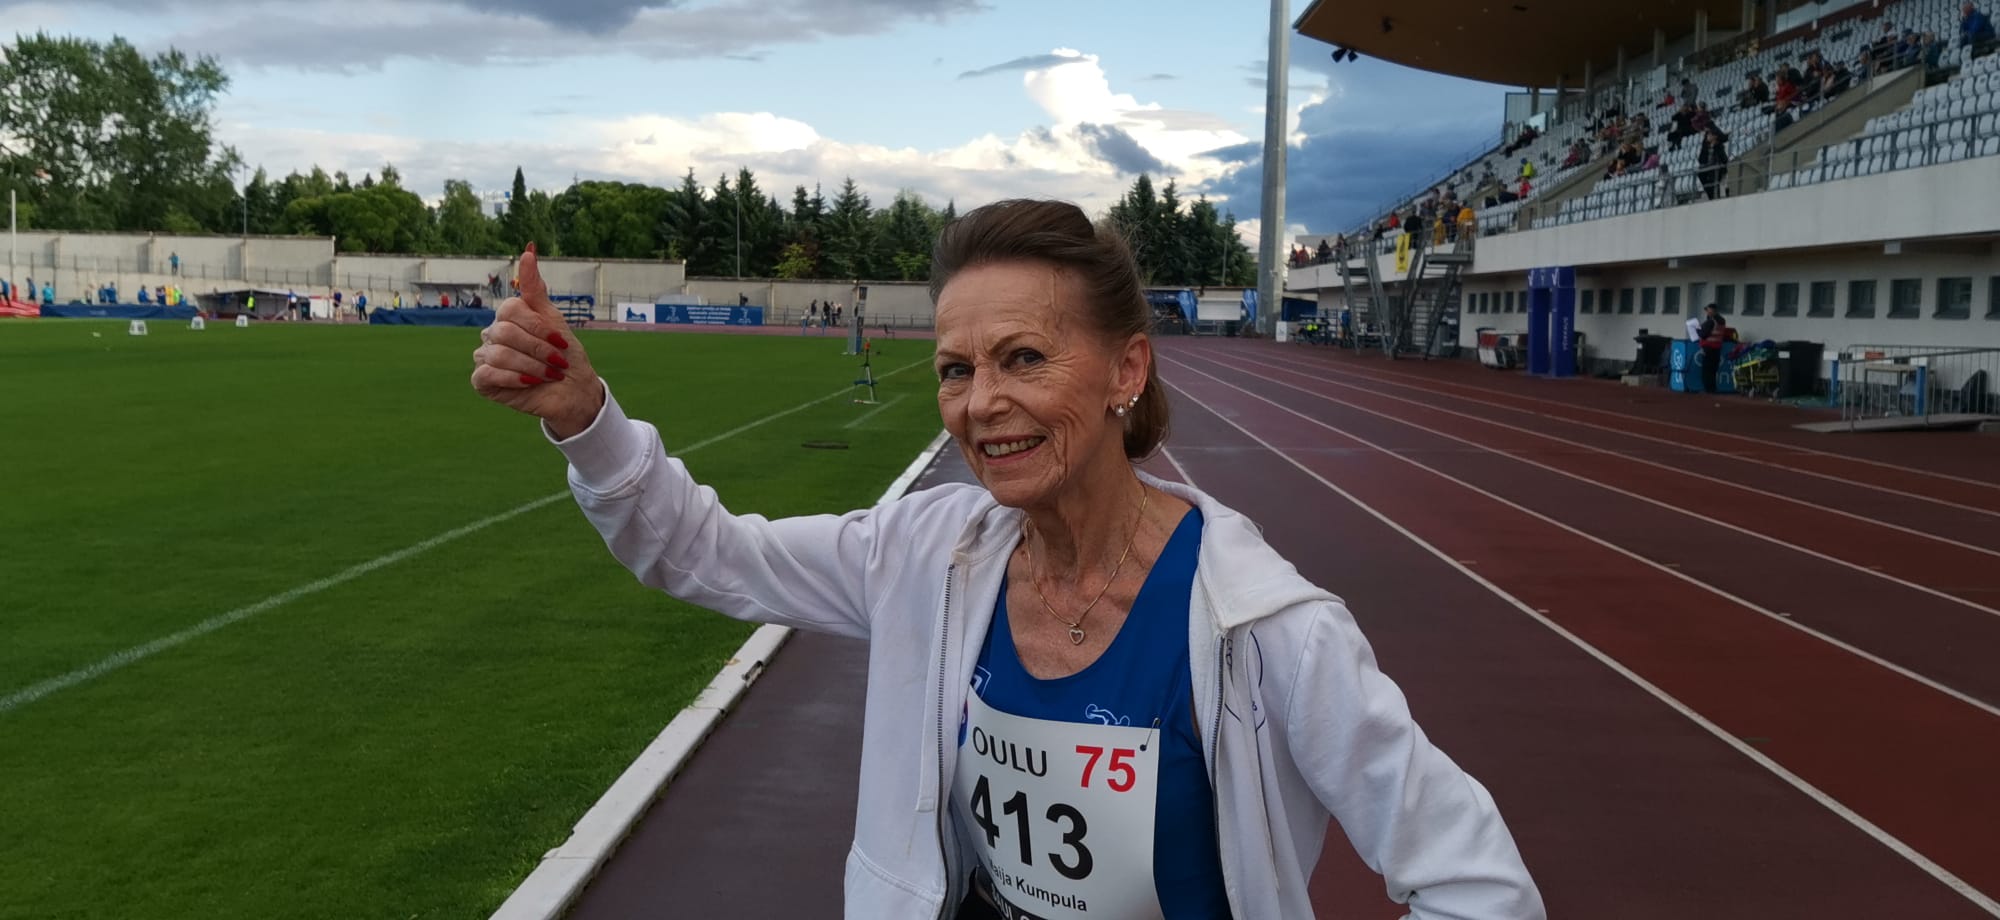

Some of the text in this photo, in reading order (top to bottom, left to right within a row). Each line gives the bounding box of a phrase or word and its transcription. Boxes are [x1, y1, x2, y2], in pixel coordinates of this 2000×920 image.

[972, 726, 1136, 793] OULU 75
[970, 774, 1094, 881] 413
[1016, 876, 1088, 912] Kumpula
